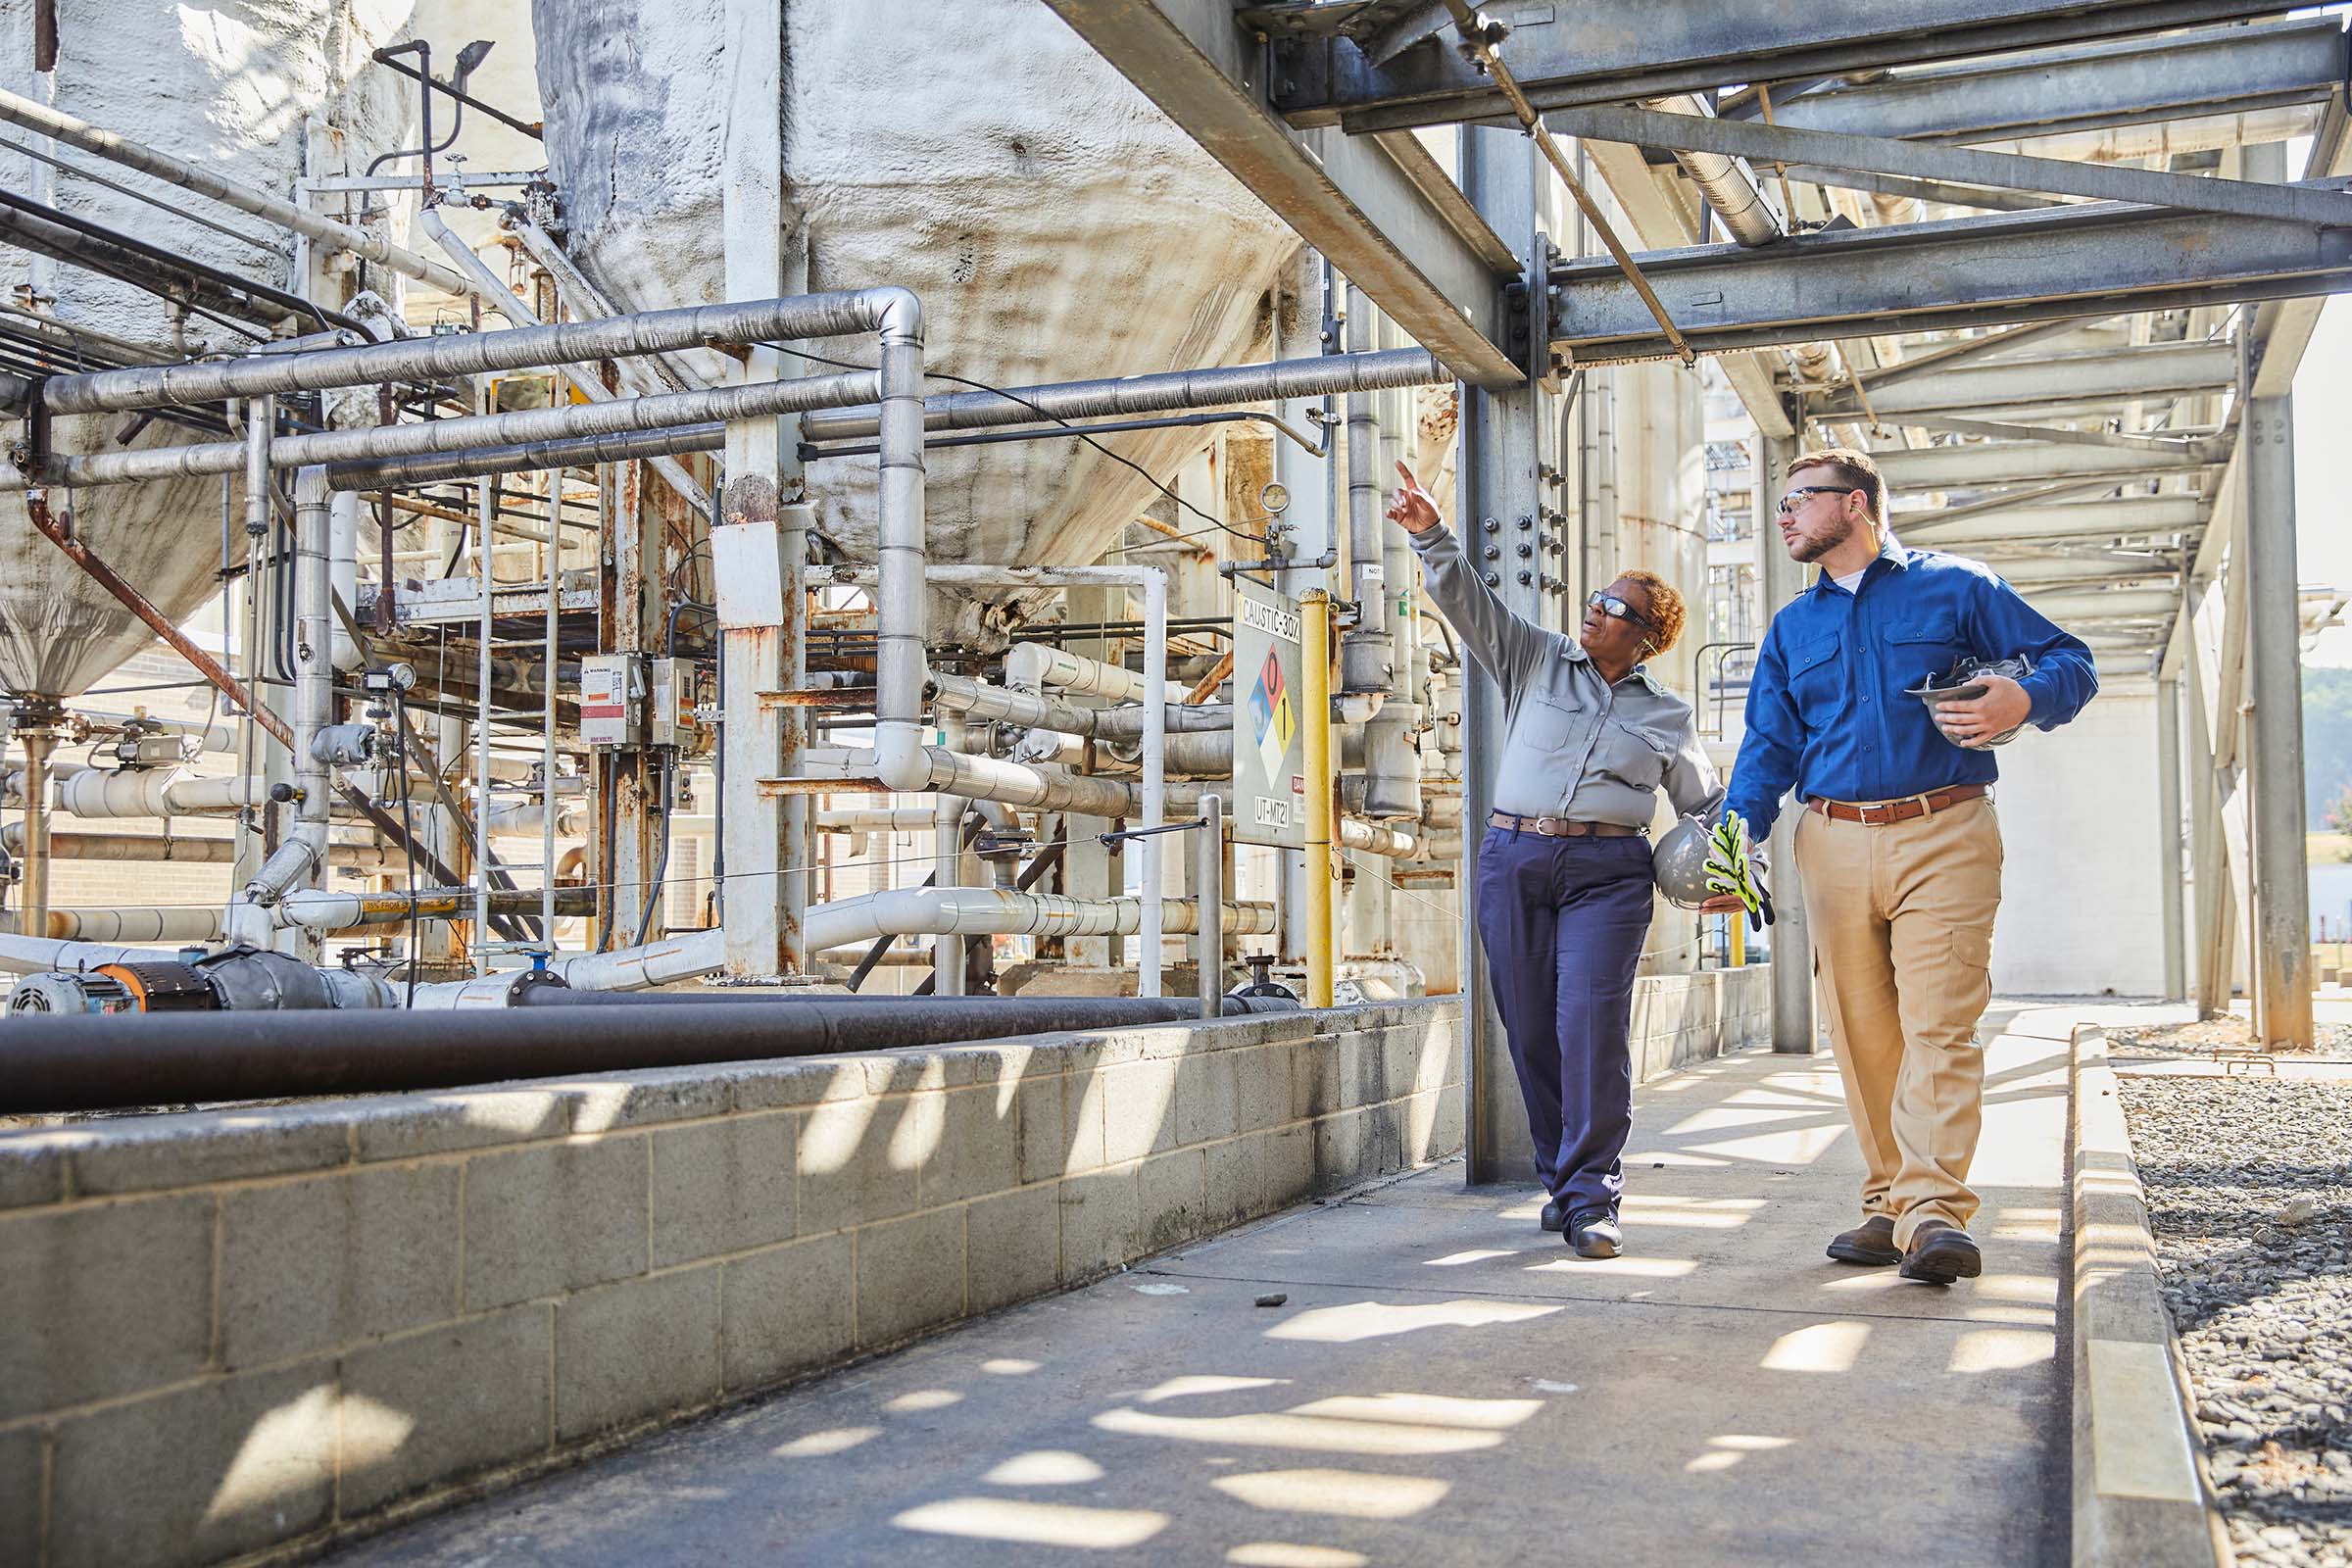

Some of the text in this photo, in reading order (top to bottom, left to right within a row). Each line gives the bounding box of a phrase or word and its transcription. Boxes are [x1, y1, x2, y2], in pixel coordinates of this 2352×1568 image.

[1244, 599, 1298, 640] CAUSTIC-30%
[1267, 652, 1278, 696] 0
[1255, 687, 1265, 731] 3
[1282, 697, 1287, 741] 1
[1256, 797, 1288, 826] UT-MT21
[381, 901, 400, 909] FROM
